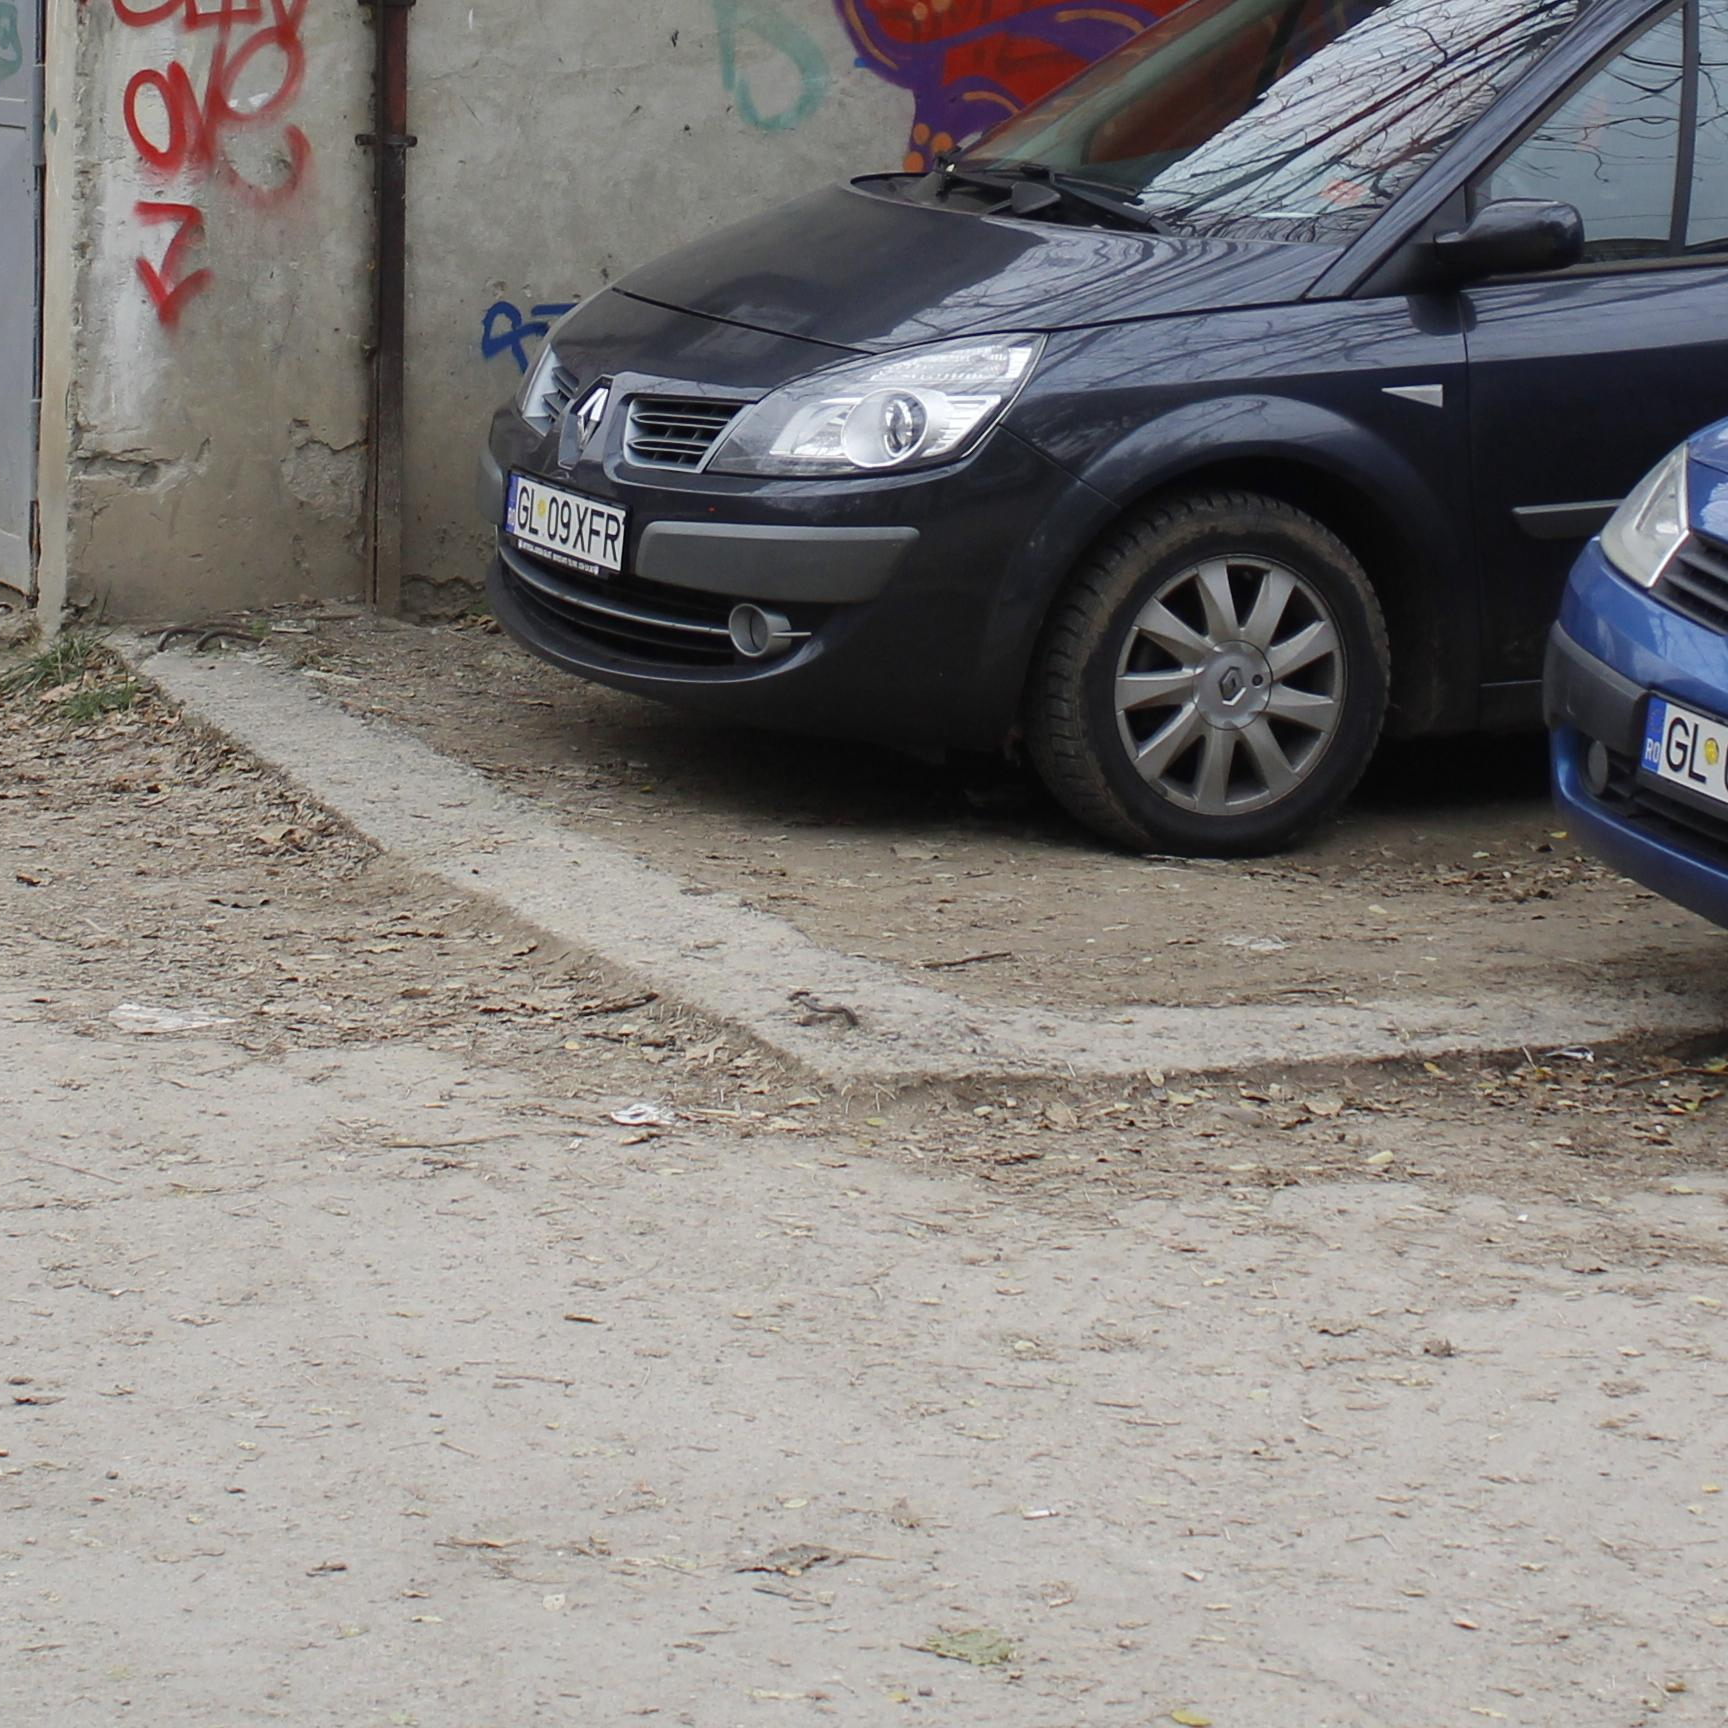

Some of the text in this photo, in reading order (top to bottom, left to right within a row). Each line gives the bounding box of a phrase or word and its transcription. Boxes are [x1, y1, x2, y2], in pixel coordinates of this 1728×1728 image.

[517, 485, 539, 536] GL
[547, 496, 572, 545] 09
[572, 503, 622, 563] XFR
[1643, 737, 1661, 764] RO
[1665, 716, 1707, 785] GL
